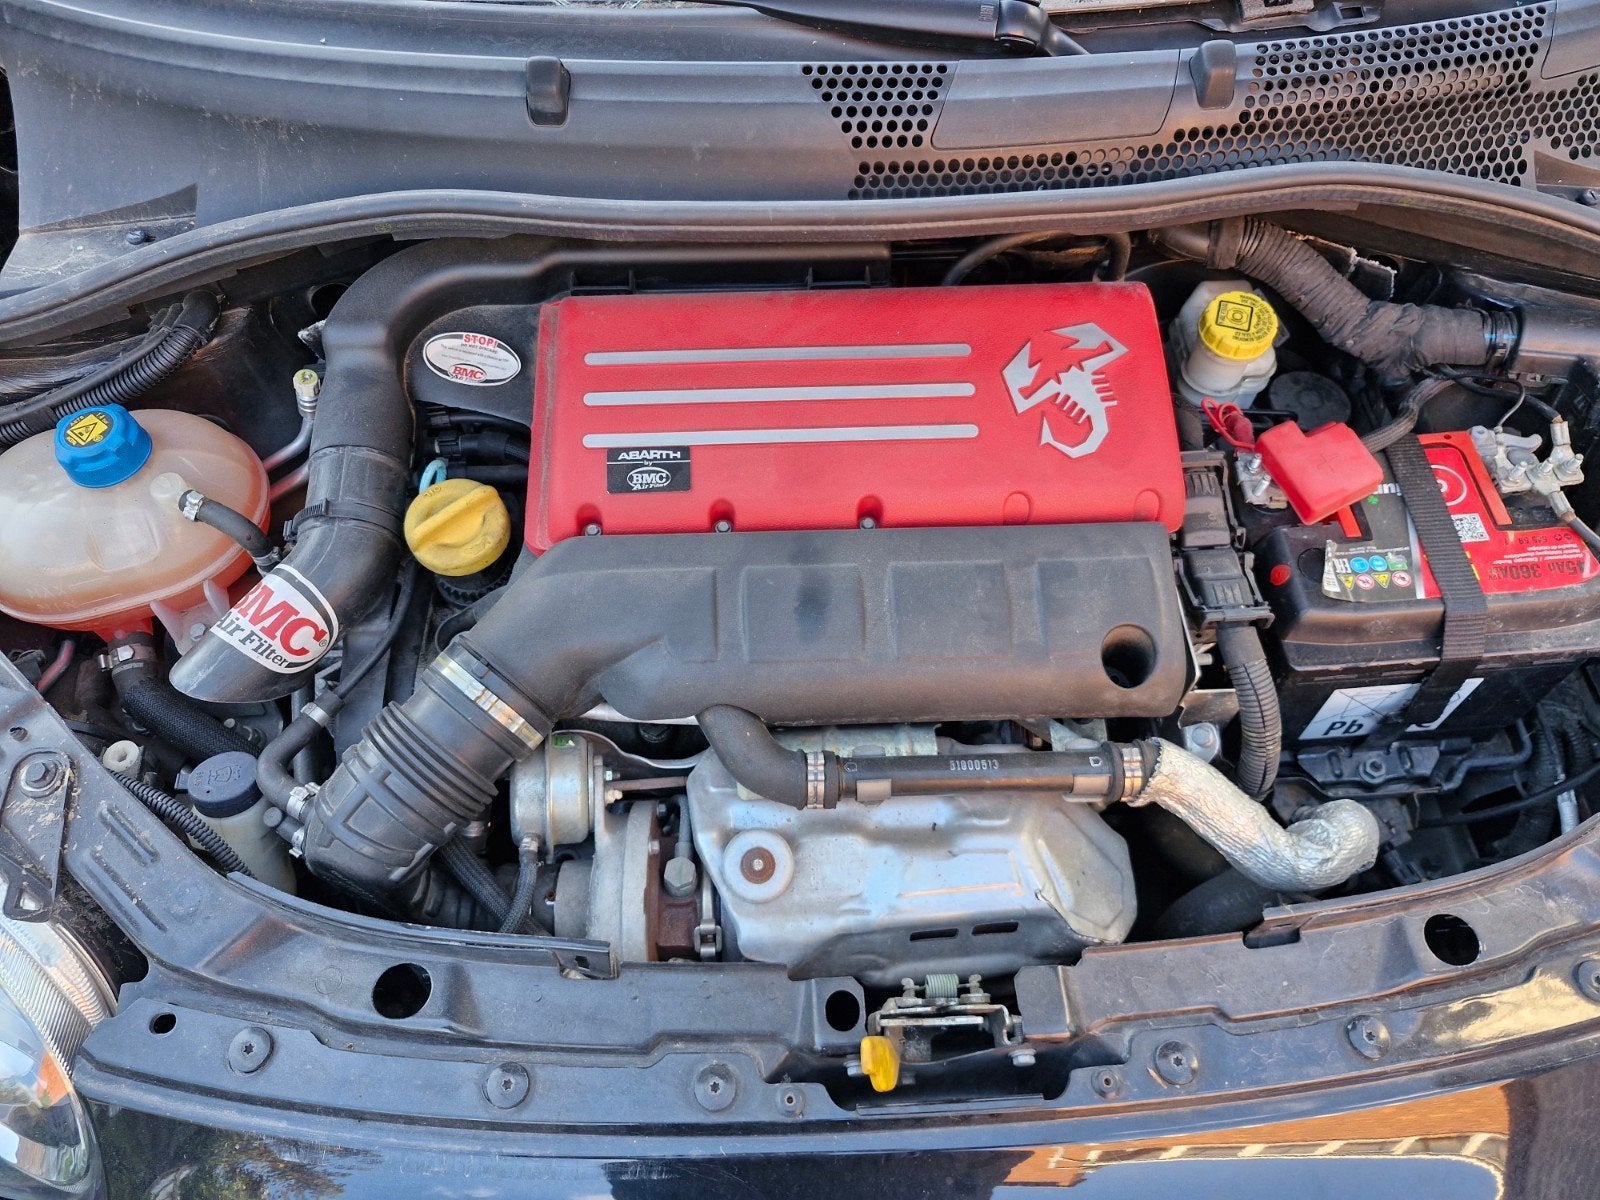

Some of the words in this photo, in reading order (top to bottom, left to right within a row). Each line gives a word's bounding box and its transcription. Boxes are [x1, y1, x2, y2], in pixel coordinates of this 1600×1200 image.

[464, 334, 498, 349] STOP!
[453, 366, 484, 380] BMC
[618, 449, 681, 460] ABARTH
[632, 472, 667, 484] BMC
[632, 483, 648, 491] Air
[238, 628, 290, 669] Filter
[1322, 720, 1364, 737] Pb
